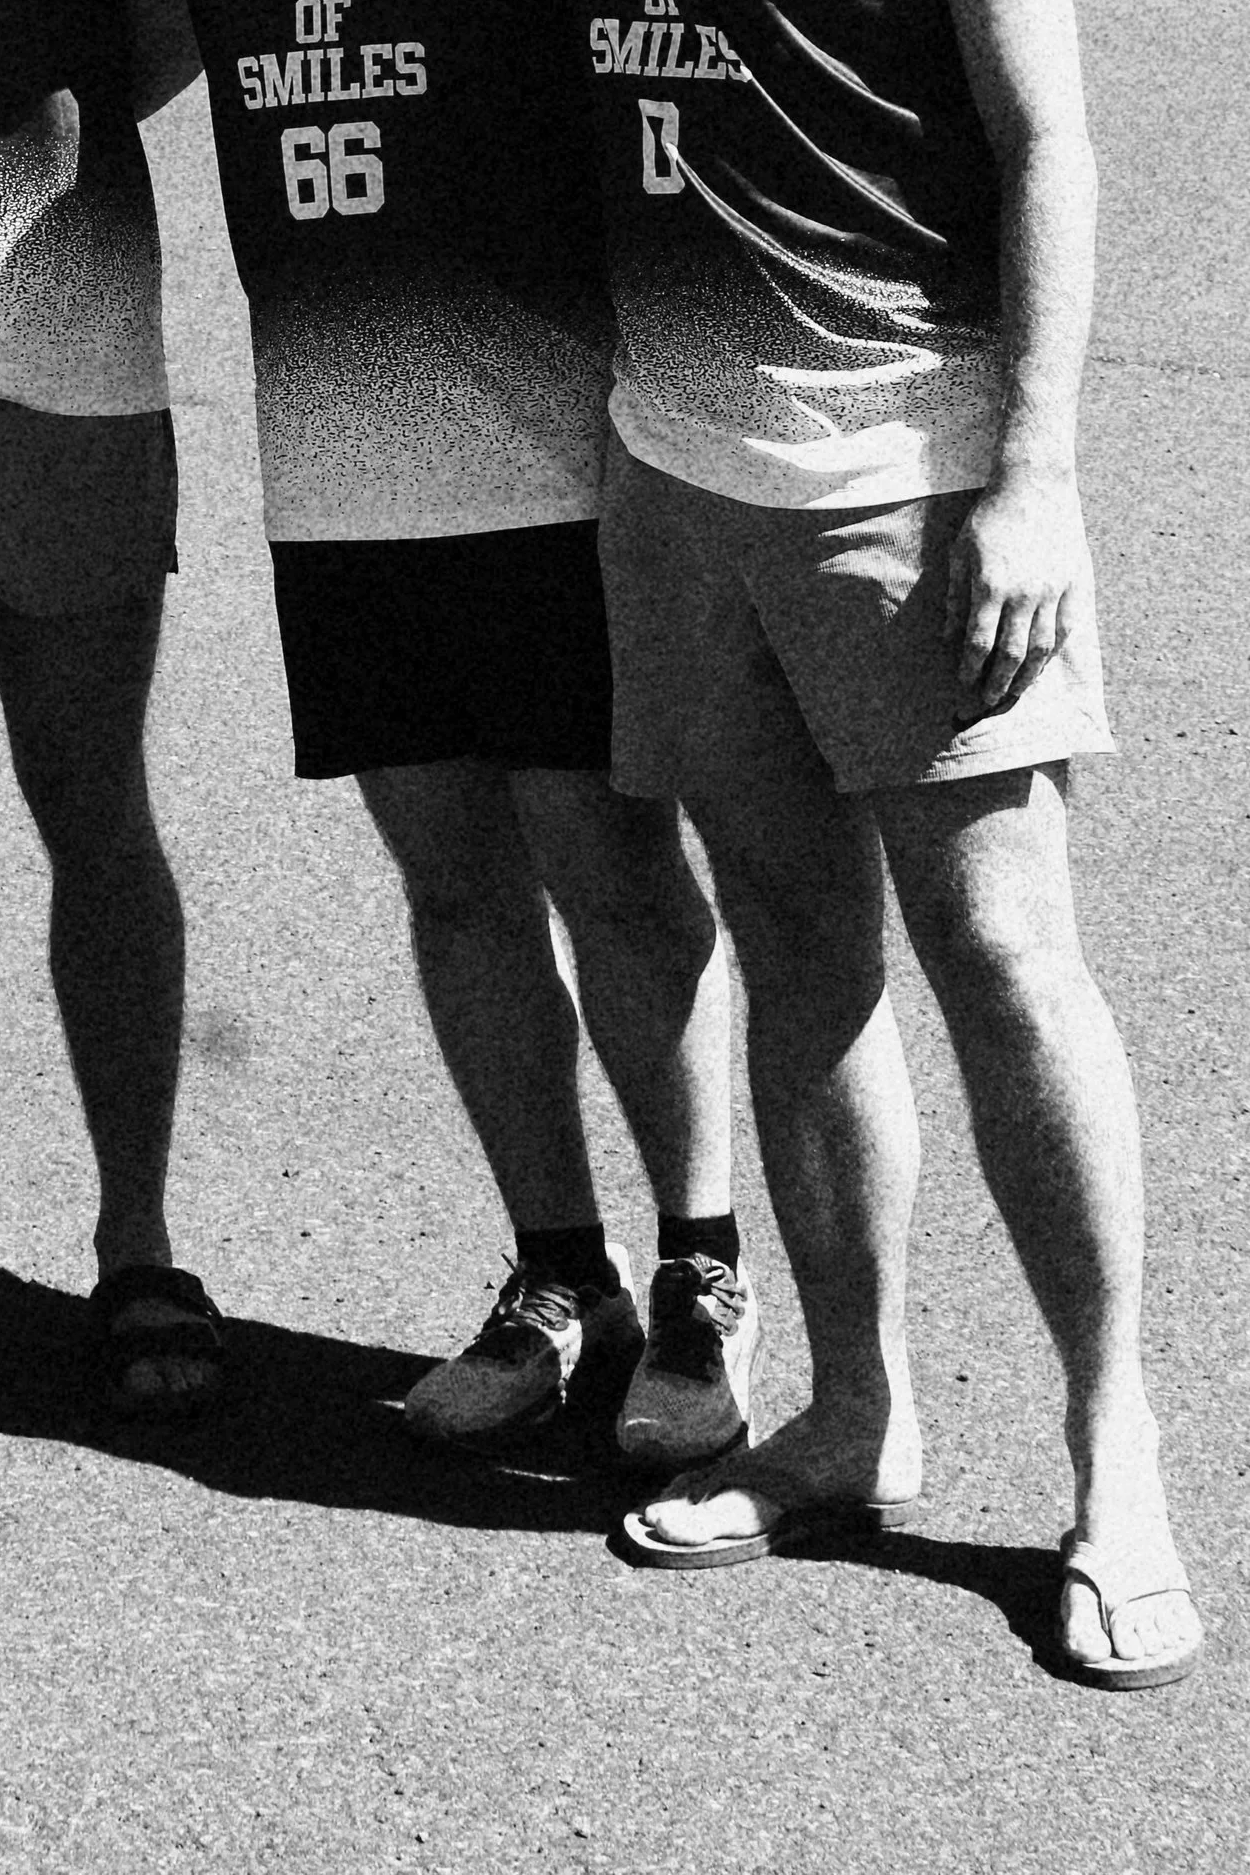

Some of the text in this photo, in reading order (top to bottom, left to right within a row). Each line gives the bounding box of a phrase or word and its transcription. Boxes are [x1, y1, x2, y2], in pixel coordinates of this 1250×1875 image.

[237, 42, 427, 110] SMILES
[590, 18, 752, 83] SMILES
[281, 121, 385, 220] 66
